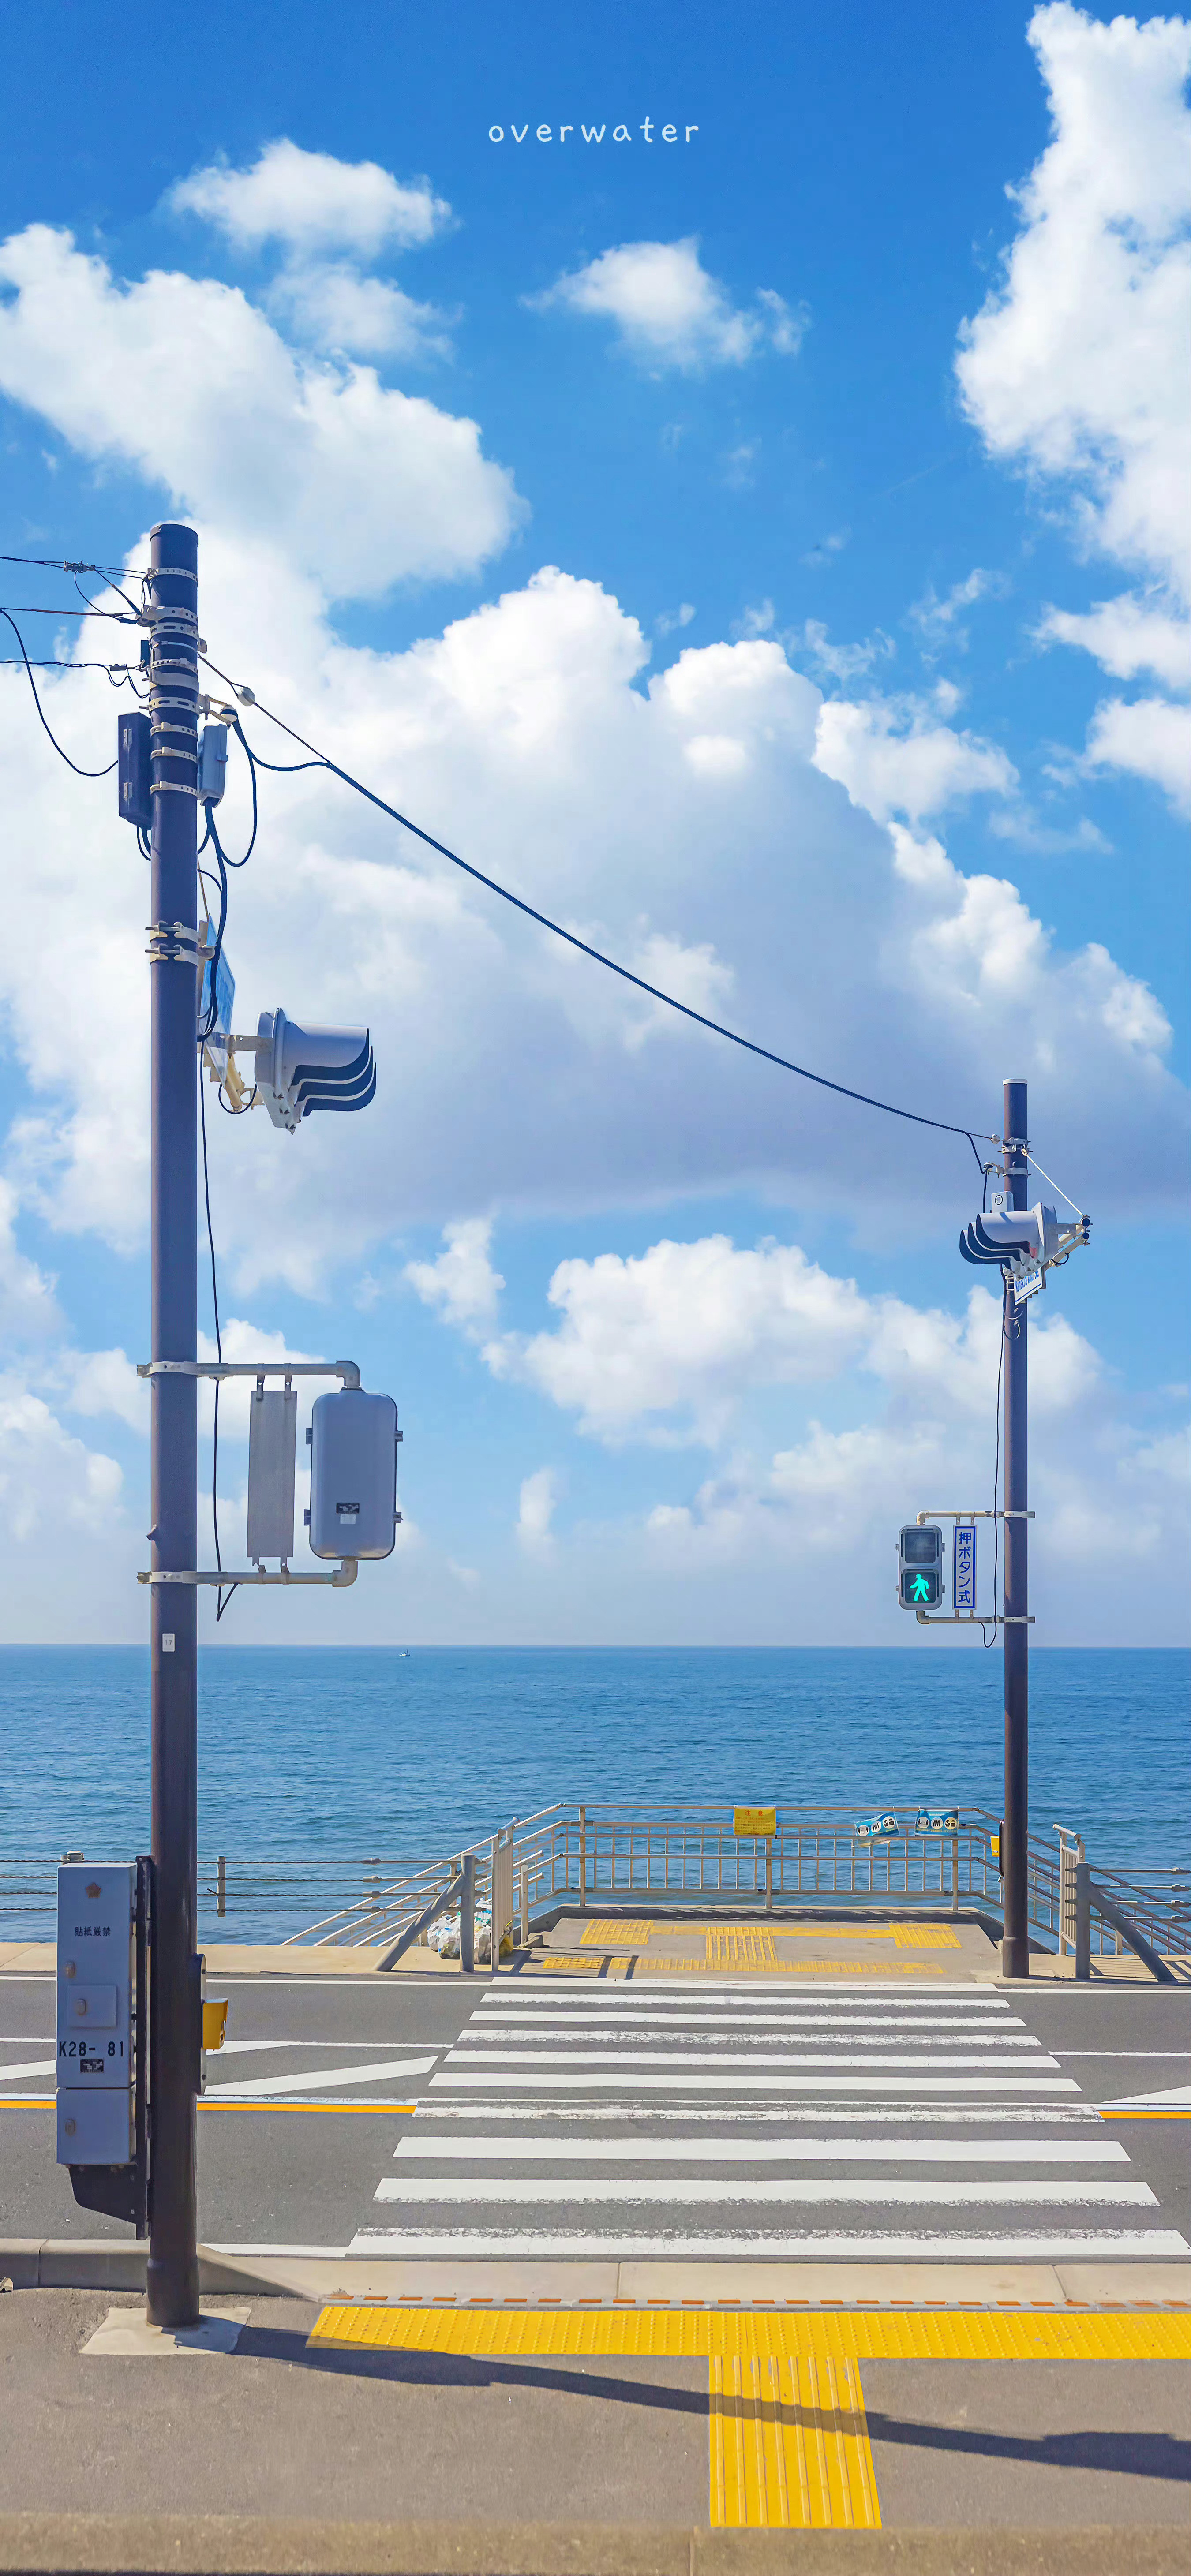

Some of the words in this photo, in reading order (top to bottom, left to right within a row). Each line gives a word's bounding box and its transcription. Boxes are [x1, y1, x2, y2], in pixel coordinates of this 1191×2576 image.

[958, 1532, 971, 1603] 押ボタン式
[75, 1926, 111, 1937] 貼紙厳禁
[108, 2041, 123, 2057] 81
